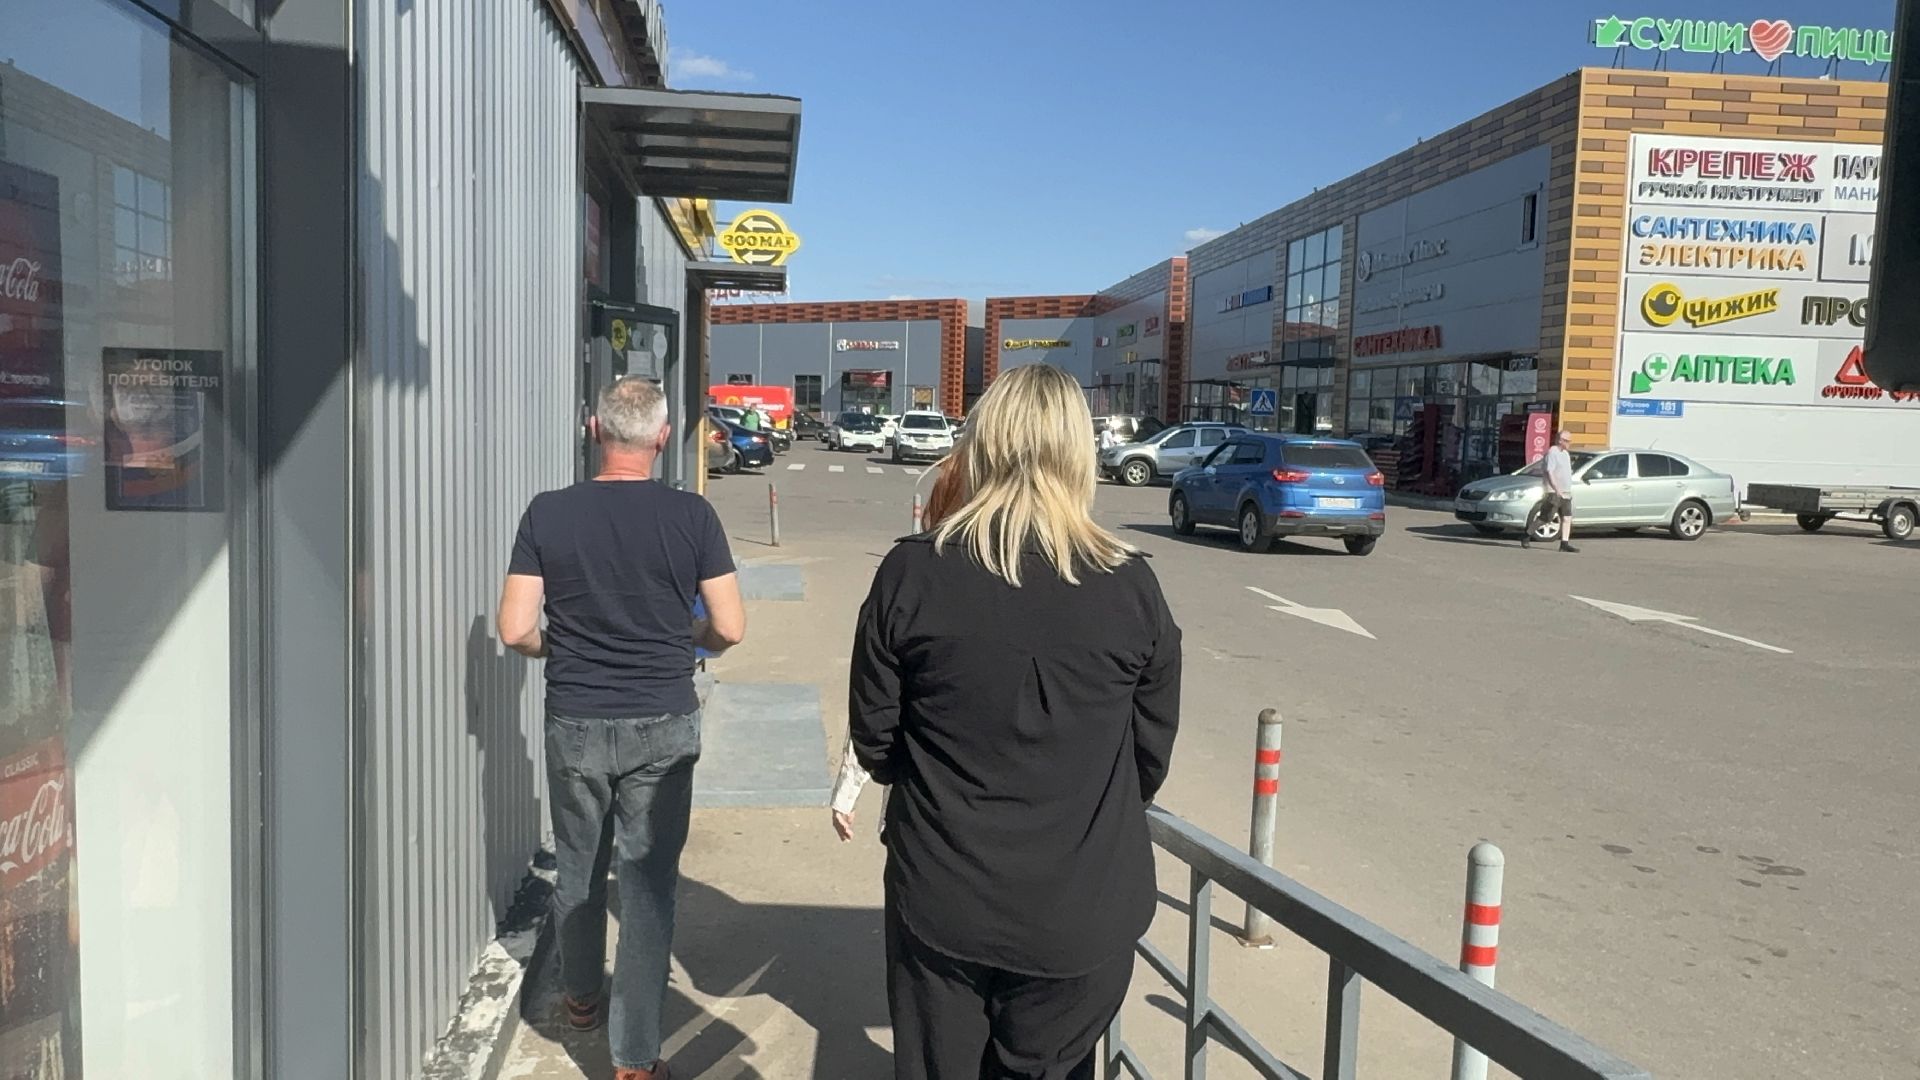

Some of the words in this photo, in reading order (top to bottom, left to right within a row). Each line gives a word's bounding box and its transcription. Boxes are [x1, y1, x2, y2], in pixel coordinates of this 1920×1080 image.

[1629, 16, 1745, 55] СУШИ
[1648, 147, 1819, 182] КРЕПЕЖ
[1638, 180, 1707, 199] РУЧНОЙ
[1711, 184, 1824, 204] ИНСТРУМЕНТ
[1632, 215, 1816, 245] САНТЕХНИКА
[1639, 243, 1809, 271] ЭЛЕКТРИКА
[133, 359, 193, 371] УГОЛОК
[1670, 354, 1796, 386] АПТЕКА
[108, 374, 219, 388] ПОТРЕБИТЕЛЯ
